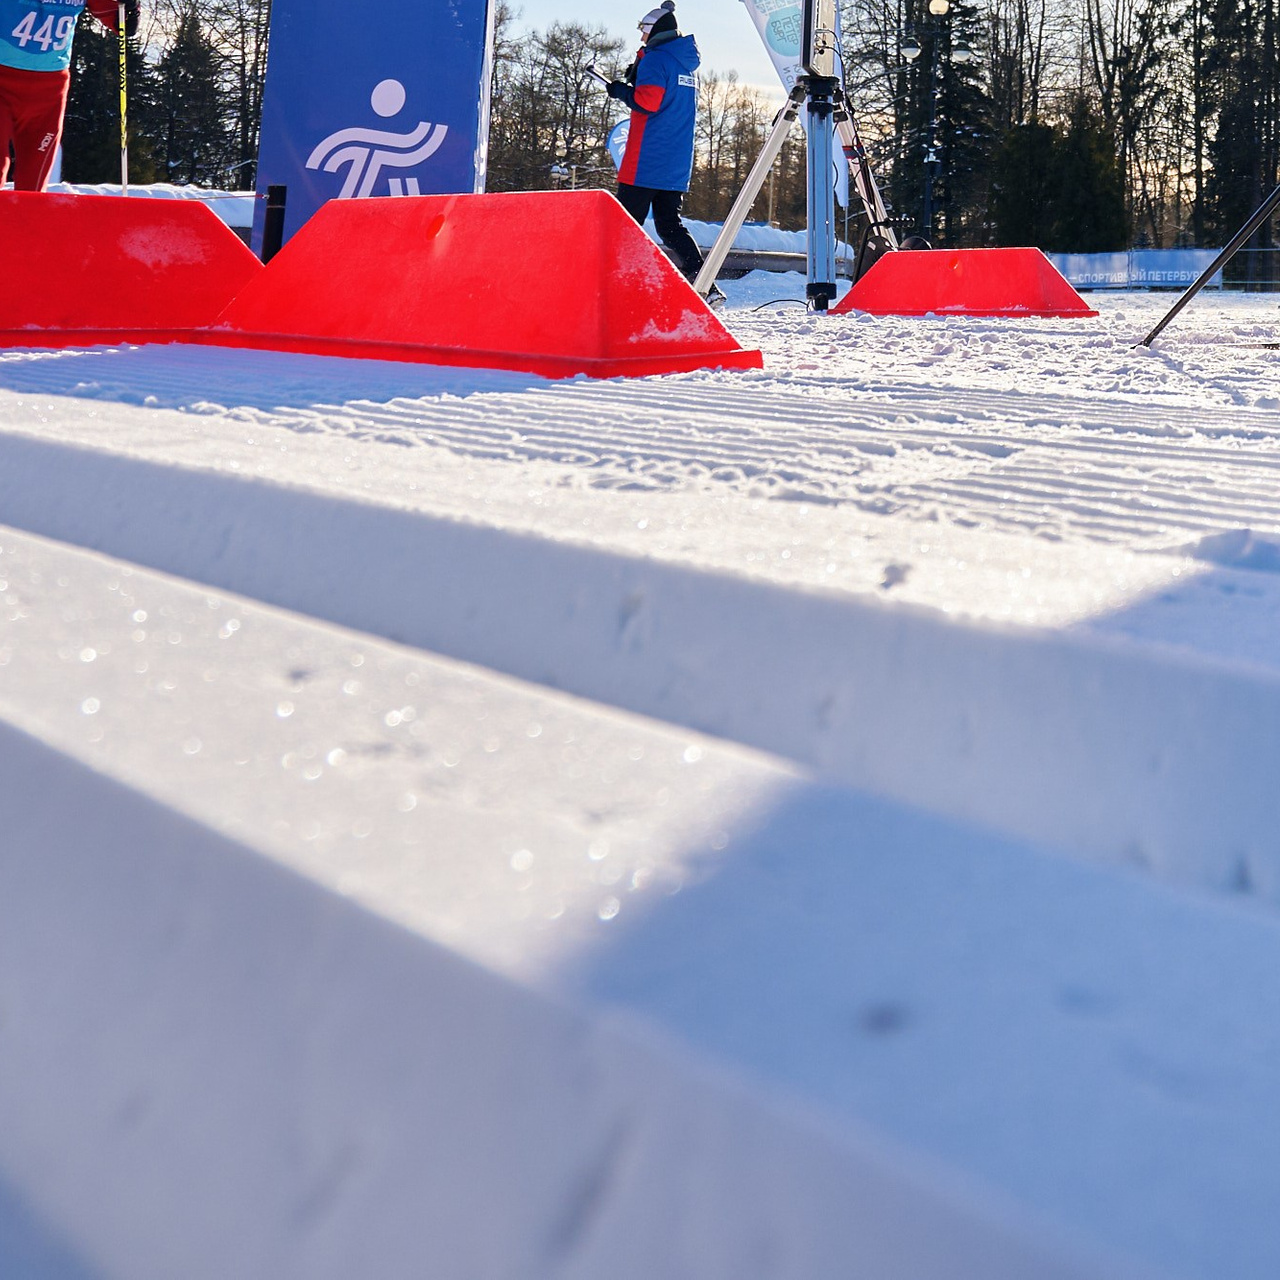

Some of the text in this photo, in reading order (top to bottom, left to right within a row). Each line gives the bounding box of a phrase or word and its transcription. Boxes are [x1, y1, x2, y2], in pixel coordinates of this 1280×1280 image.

[12, 11, 74, 51] 449
[771, 20, 788, 43] БУРГ
[781, 16, 799, 46] ПЕТЕР
[1148, 270, 1201, 282] ПЕТЕРБУР
